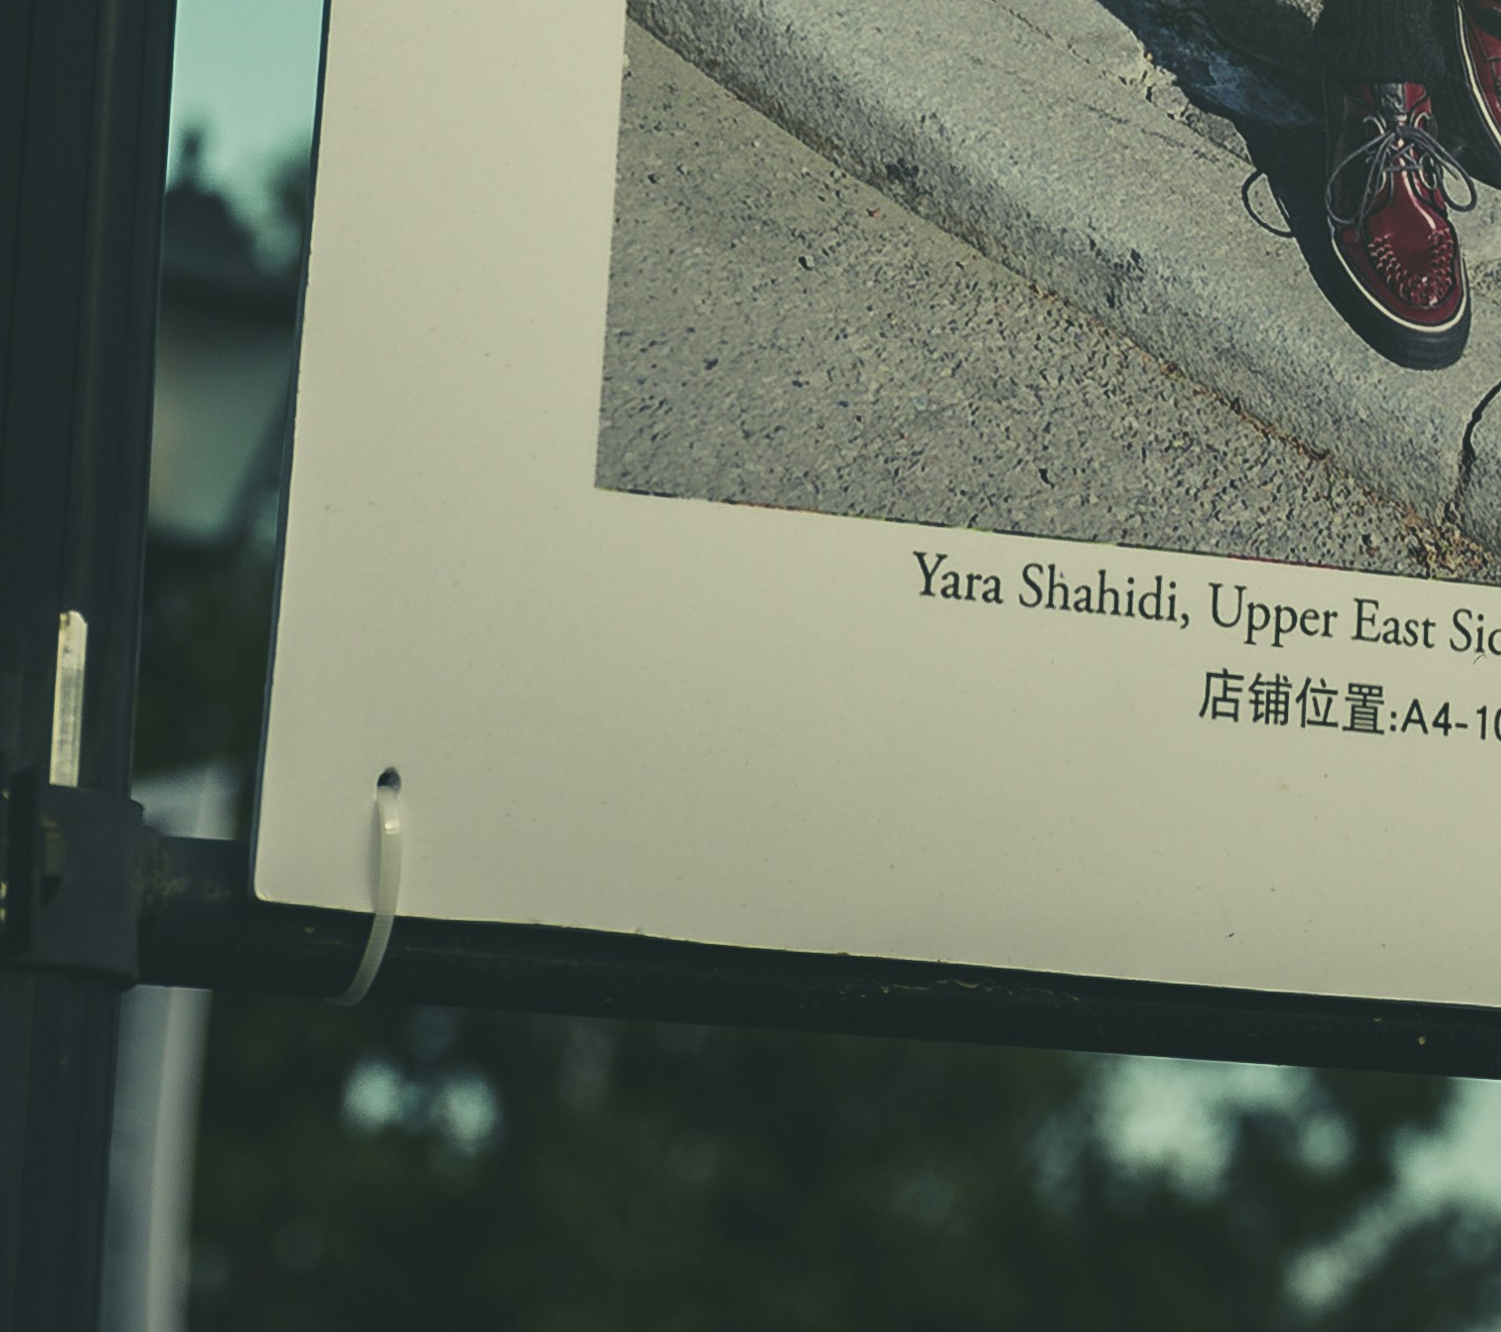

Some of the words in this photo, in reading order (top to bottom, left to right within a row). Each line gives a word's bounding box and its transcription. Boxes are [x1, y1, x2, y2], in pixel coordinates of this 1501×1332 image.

[911, 550, 1004, 605] Yara
[1017, 562, 1190, 630] Shahidi,
[1207, 581, 1339, 649] Upper
[1350, 597, 1437, 650] East
